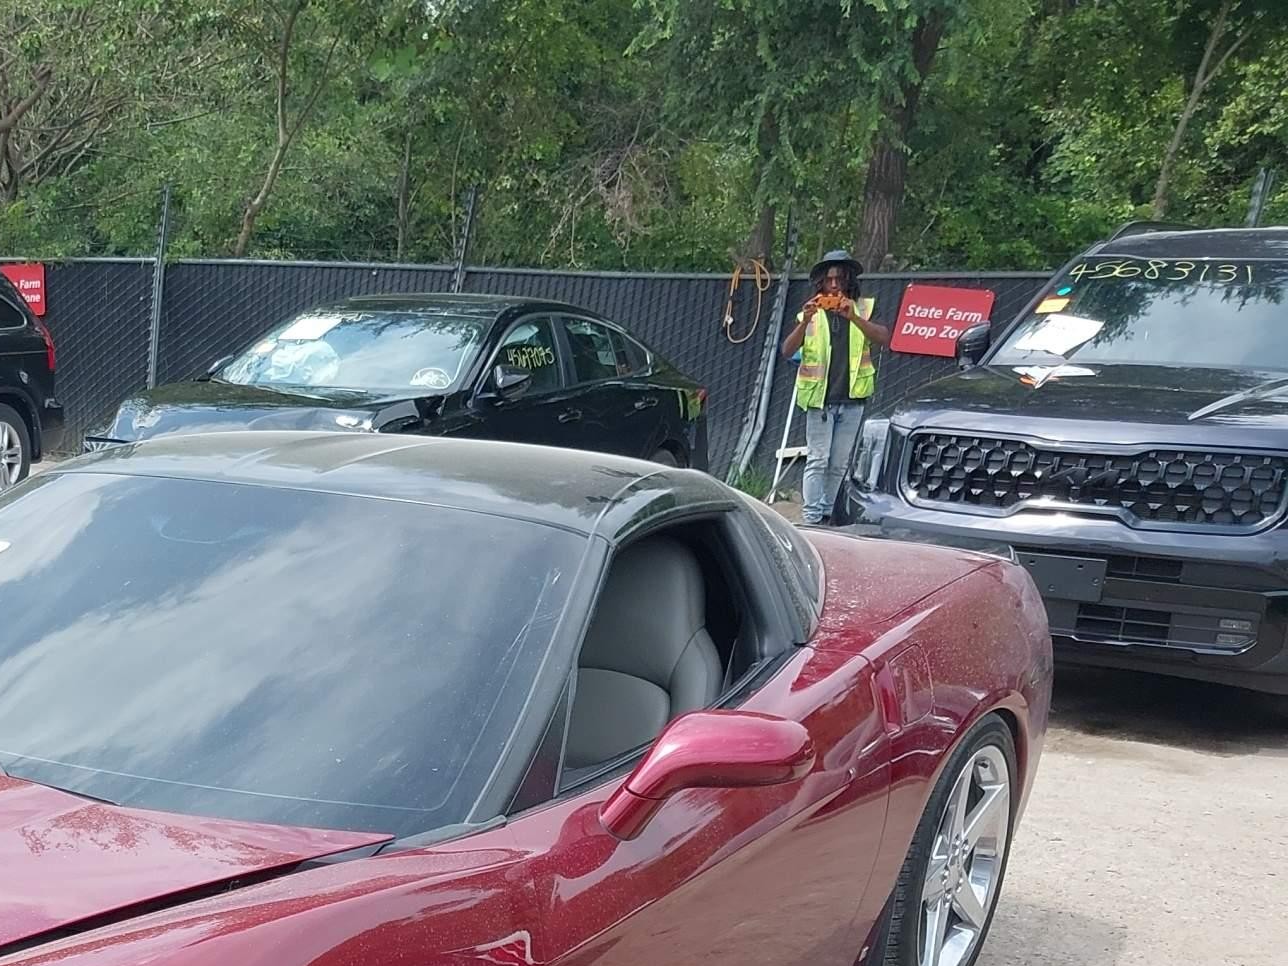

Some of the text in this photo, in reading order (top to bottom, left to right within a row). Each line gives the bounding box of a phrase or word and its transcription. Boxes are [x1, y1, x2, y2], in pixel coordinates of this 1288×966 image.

[1069, 260, 1253, 284] 45683131
[19, 279, 41, 289] Farm
[22, 292, 41, 303] one
[905, 304, 982, 322] State Farm
[901, 322, 964, 340] Drop Zo
